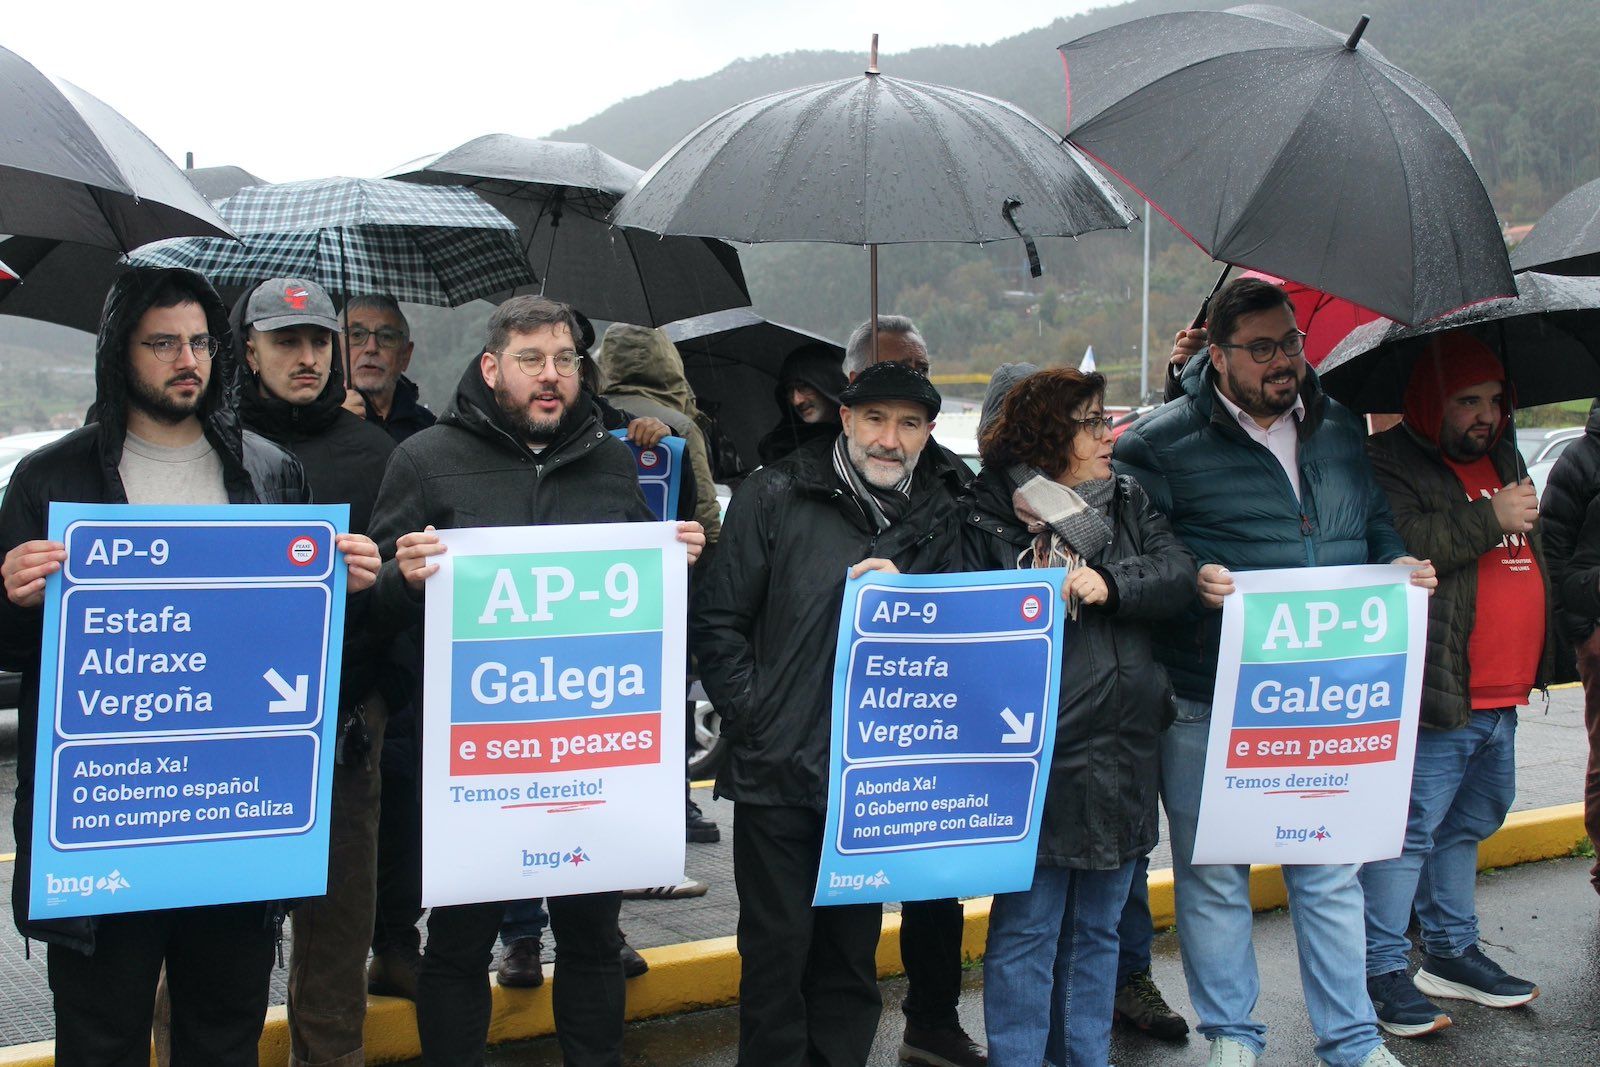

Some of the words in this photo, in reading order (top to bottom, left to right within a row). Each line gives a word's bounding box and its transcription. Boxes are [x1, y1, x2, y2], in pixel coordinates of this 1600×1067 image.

[85, 538, 169, 566] AP-9
[478, 562, 640, 624] AP-9
[84, 606, 191, 634] Estafa
[871, 601, 938, 623] AP-9
[1262, 596, 1388, 650] AP-9
[79, 648, 207, 675] Aldraxe
[865, 655, 949, 677] Estafa
[470, 656, 645, 710] Galega
[78, 686, 213, 721] Vergoña
[859, 687, 958, 709] Aldraxe
[1250, 676, 1391, 719] Galega
[459, 741, 477, 760] e
[487, 737, 542, 760] sen
[550, 729, 653, 763] peaxes
[858, 720, 959, 748] Vergoña
[1235, 740, 1248, 757] e
[1256, 737, 1302, 756] sen
[1307, 733, 1393, 760] peaxes
[73, 757, 152, 778] Abonda
[156, 756, 189, 774] Xa!
[73, 787, 88, 804] O
[92, 781, 178, 802] Goberno
[182, 777, 259, 801] español
[450, 785, 520, 803] Temos
[527, 778, 603, 800] dereito!
[855, 778, 910, 796] Abonda
[912, 776, 936, 791] Xa!
[1225, 775, 1281, 789] Temos
[1285, 773, 1349, 788] dereito!
[72, 811, 110, 829] non
[115, 806, 191, 830] cumpre
[195, 804, 231, 822] con
[235, 801, 294, 819] Galiza
[855, 803, 866, 818] O
[868, 799, 928, 817] Goberno
[931, 794, 989, 813] español
[853, 823, 881, 839] non
[883, 819, 937, 839] cumpre
[940, 817, 966, 831] con
[968, 814, 1014, 829] Galiza
[1276, 825, 1308, 842] bng
[522, 849, 560, 868] bng
[46, 873, 94, 896] bng
[829, 871, 864, 890] bng
